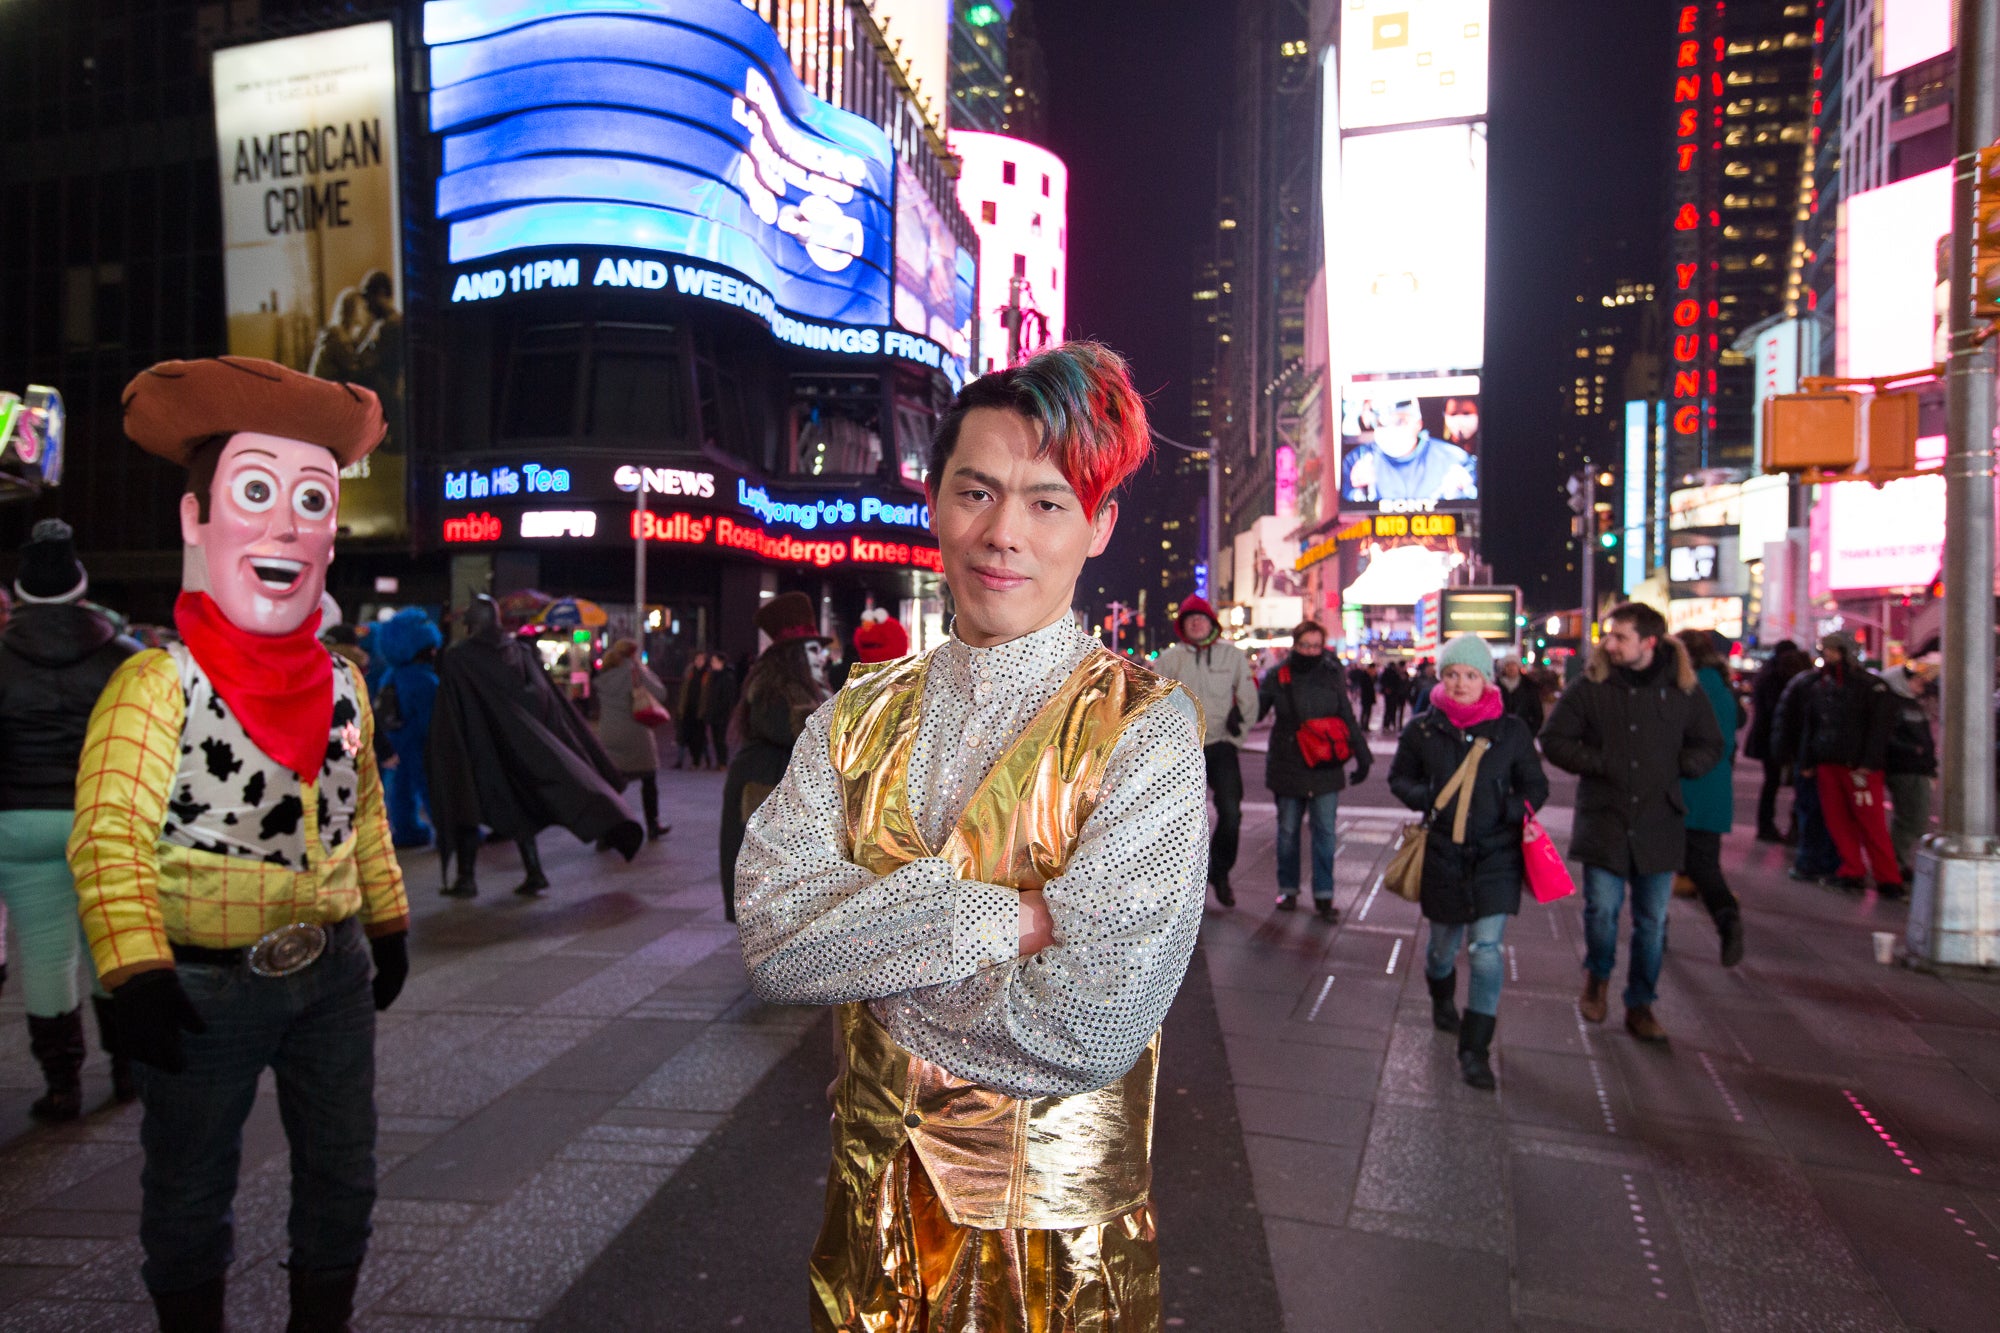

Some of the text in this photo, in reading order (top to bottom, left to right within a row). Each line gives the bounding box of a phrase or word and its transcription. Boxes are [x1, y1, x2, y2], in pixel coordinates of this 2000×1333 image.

[234, 117, 383, 185] AMERICAN
[264, 179, 352, 236] CRIME
[1673, 5, 1700, 434] ERNST & YOUNG
[452, 258, 579, 302] AND 11PM
[593, 258, 668, 289] AND
[770, 309, 880, 354] ORNINGS
[884, 331, 940, 367] FROM
[470, 471, 489, 498] in
[522, 463, 571, 493] Tea
[642, 467, 716, 498] NEWS
[862, 497, 918, 527] Pearl
[1379, 499, 1438, 513] SONY
[630, 508, 713, 543] Bulls'
[851, 535, 911, 564] knee
